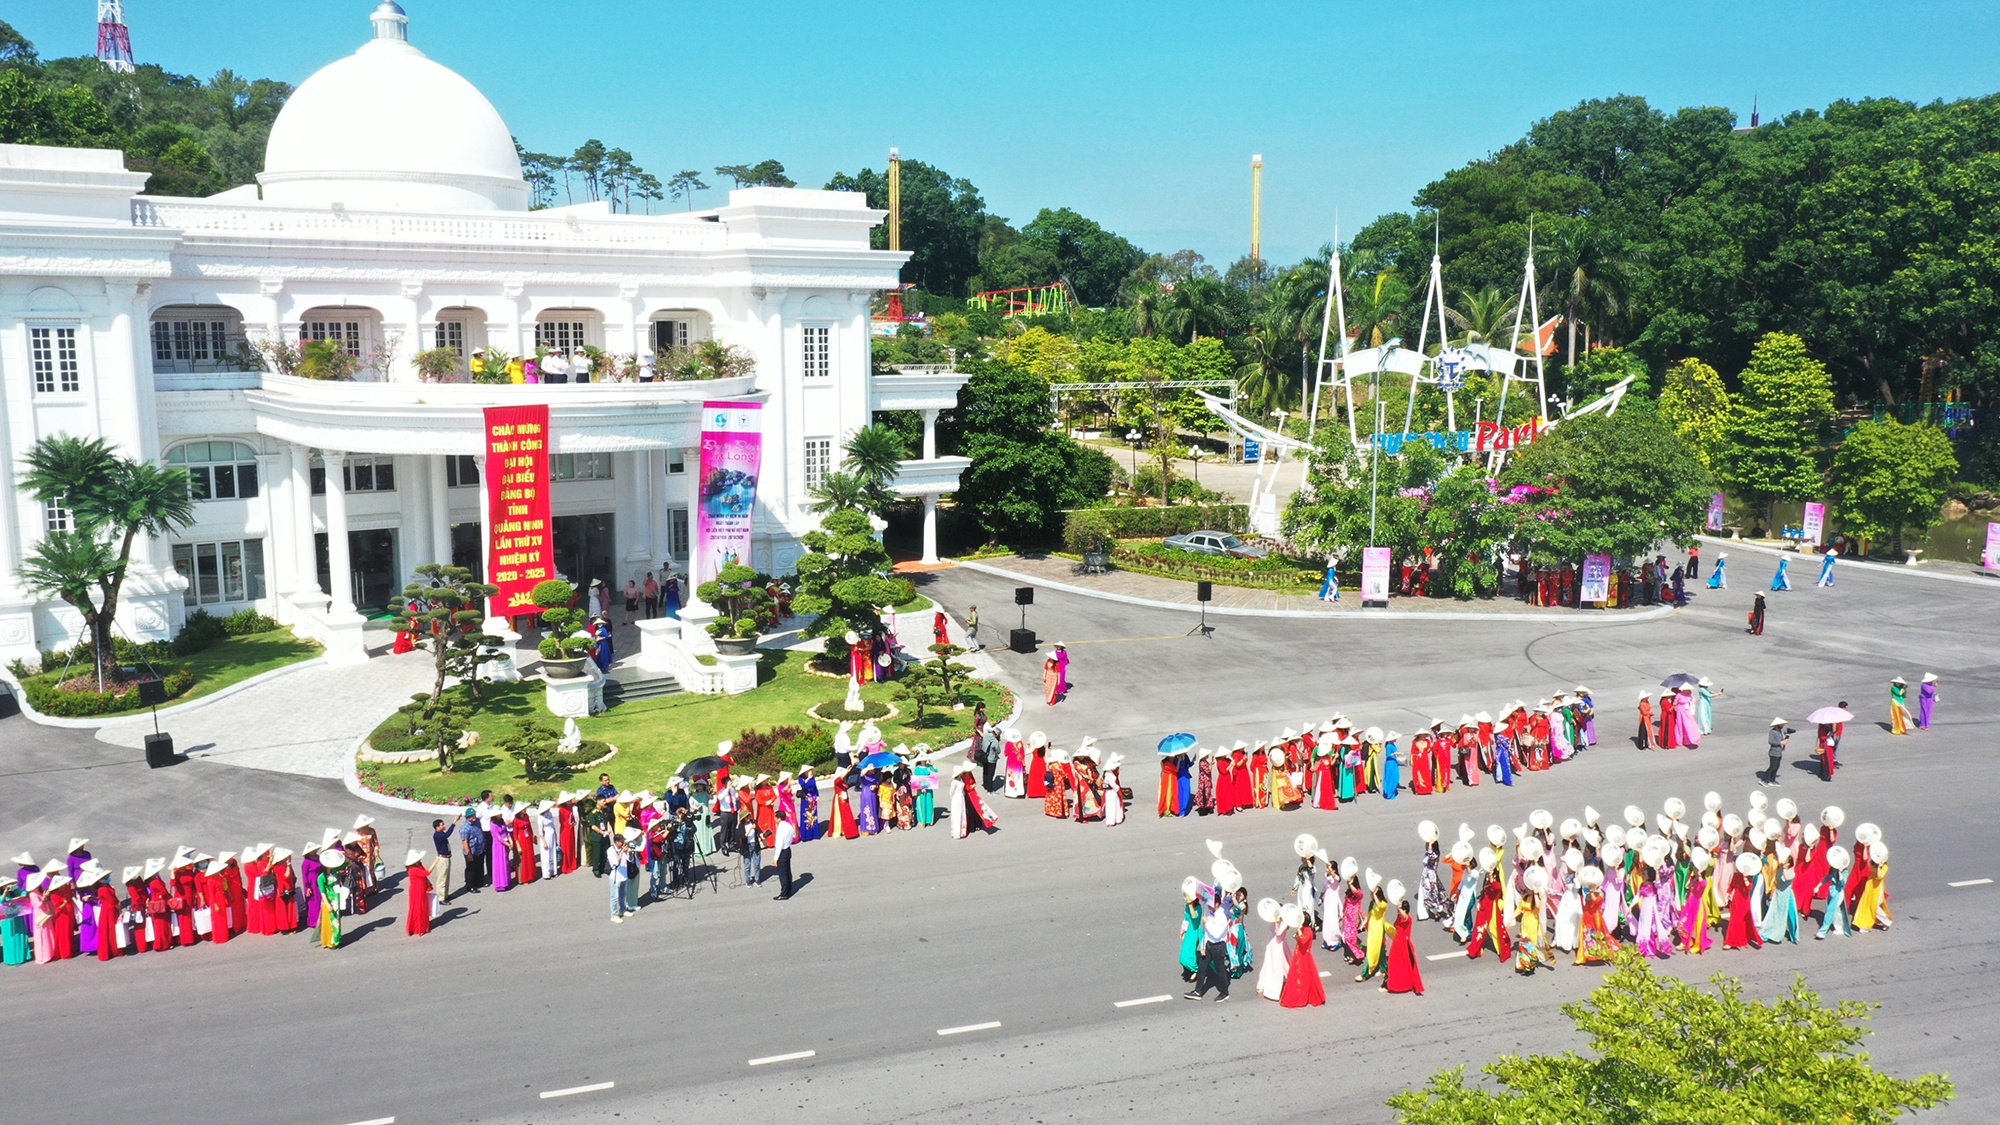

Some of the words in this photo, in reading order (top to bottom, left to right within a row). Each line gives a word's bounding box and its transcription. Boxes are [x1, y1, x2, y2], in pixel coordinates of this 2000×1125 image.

[520, 438, 542, 451] CÔNG
[518, 454, 533, 468] HỘI
[728, 452, 754, 463] Long
[516, 469, 535, 483] BIỂU
[524, 487, 535, 500] BỘ
[508, 502, 528, 516] TỈNH
[494, 519, 522, 534] QUẢNG
[523, 519, 543, 531] NINH
[514, 535, 531, 548] THỨ
[531, 535, 543, 546] XV
[500, 552, 527, 566] NHIỆM
[496, 571, 518, 582] 2020
[525, 568, 546, 579] 2025
